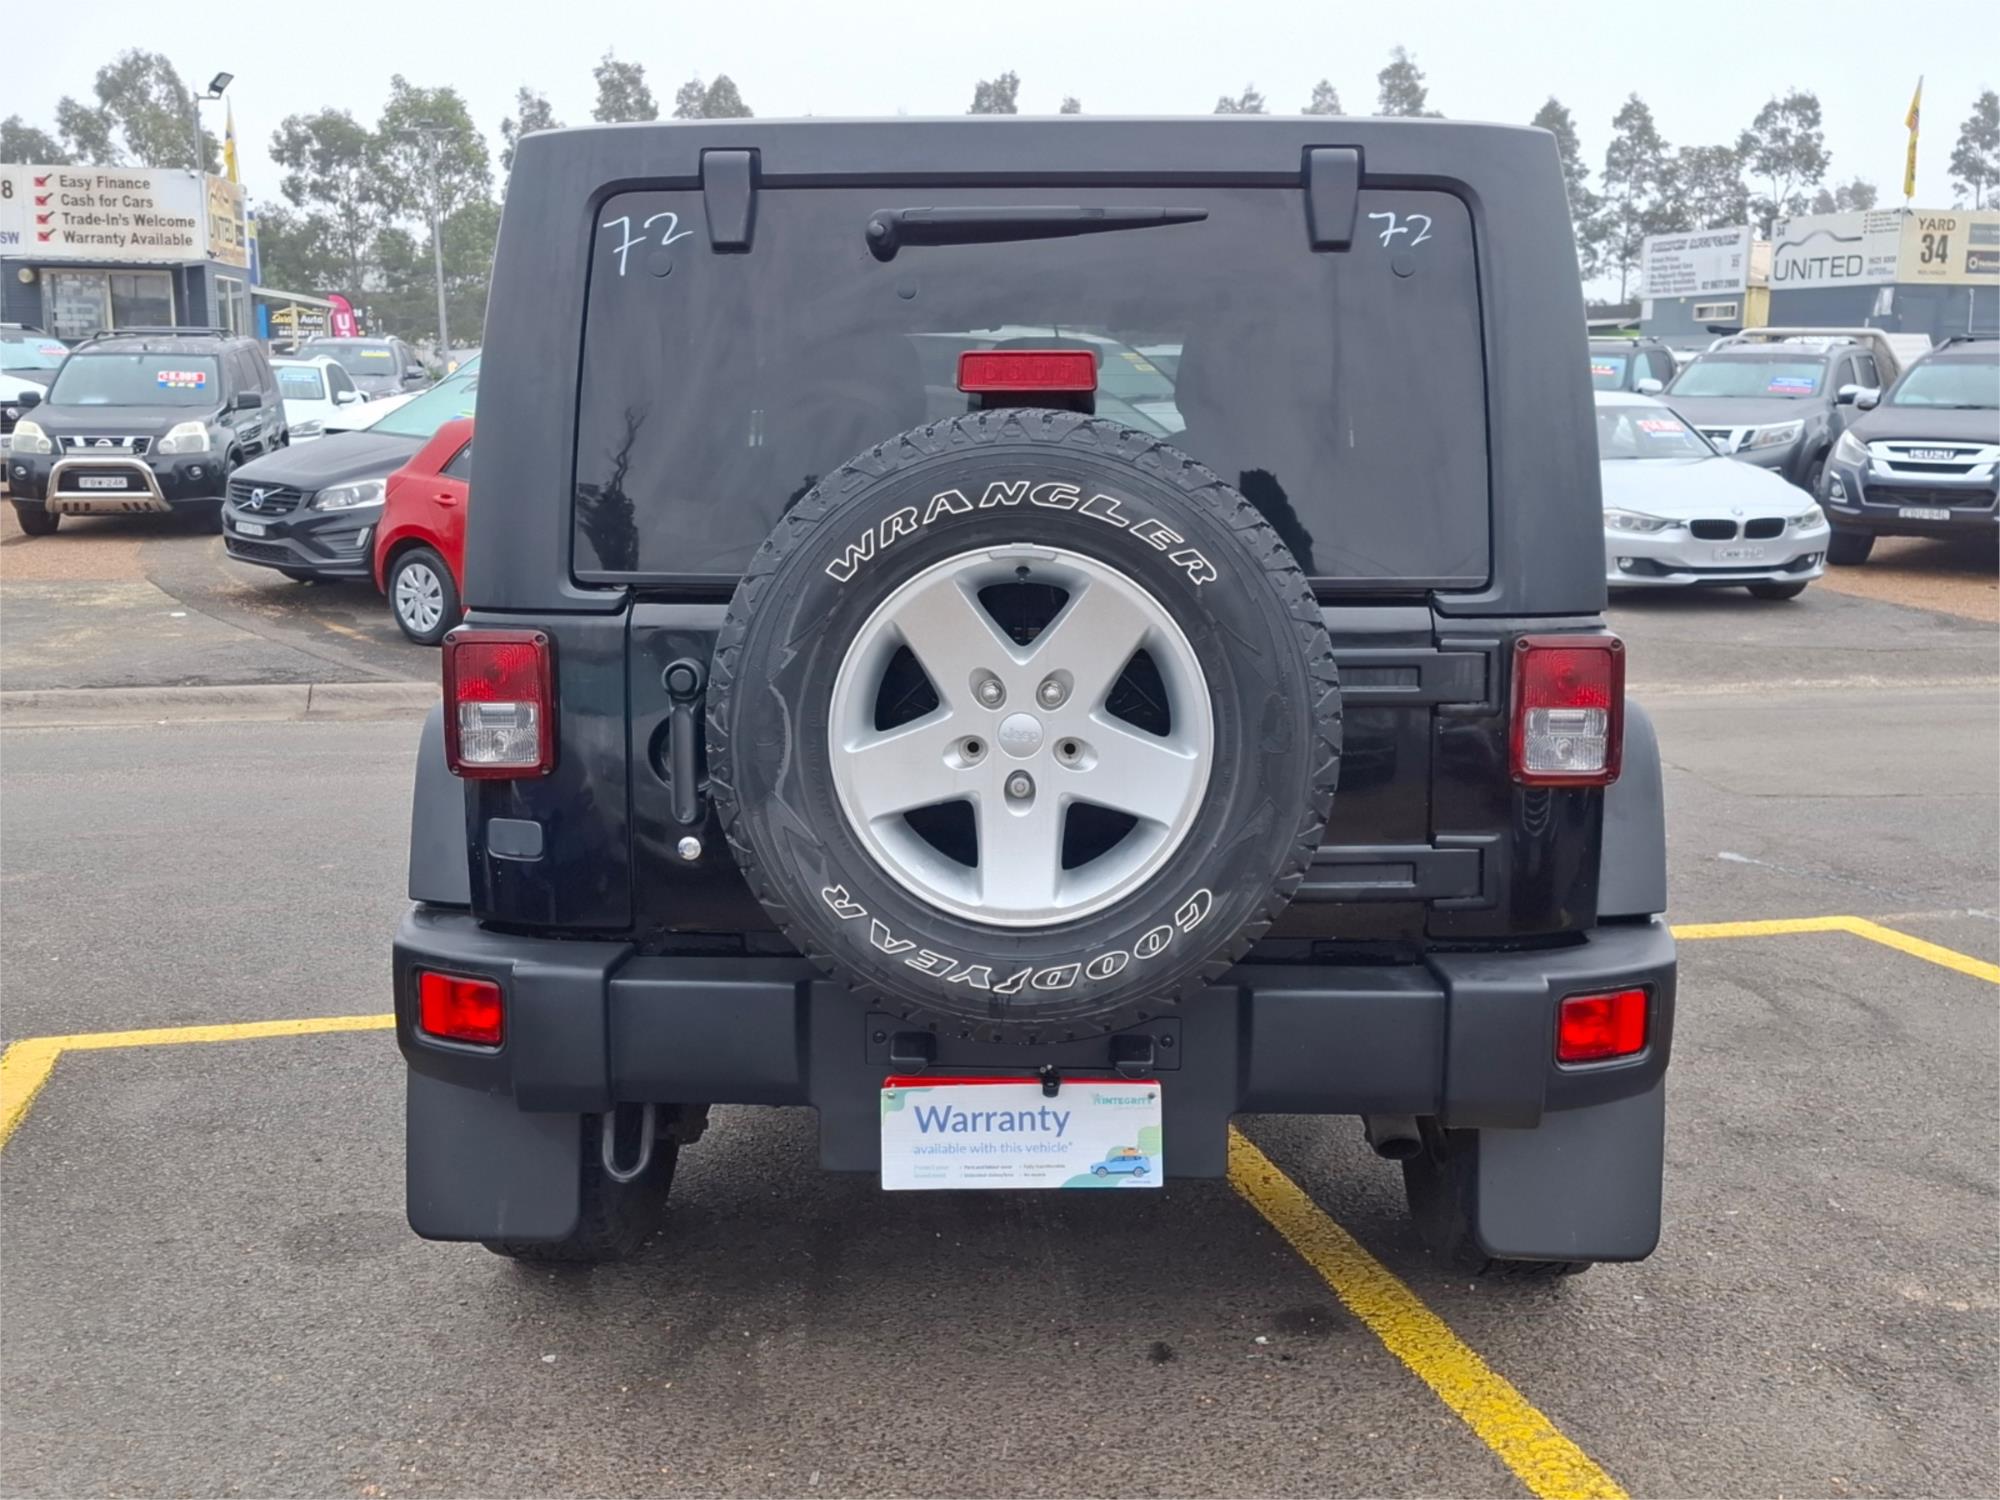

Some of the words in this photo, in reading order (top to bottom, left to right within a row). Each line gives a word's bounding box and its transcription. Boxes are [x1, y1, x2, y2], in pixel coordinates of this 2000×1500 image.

[60, 175, 92, 190] Easy
[97, 176, 150, 190] Finance
[61, 194, 95, 207] Cash
[100, 195, 117, 207] for
[123, 196, 153, 208] Cars
[62, 212, 130, 226] Trade-In's
[134, 214, 196, 228] Welcome
[1918, 217, 1957, 232] YARD
[1368, 211, 1432, 247] 72
[63, 231, 126, 247] Warranty
[131, 232, 193, 246] Available
[603, 212, 694, 276] 72
[1920, 233, 1949, 264] 34
[300, 315, 323, 324] Auto
[1909, 449, 1955, 460] ISUZU
[825, 481, 1217, 585] WRANGLER
[822, 885, 1212, 994] GOODYEAR
[914, 1104, 1071, 1138] Warranty
[913, 1143, 967, 1155] available
[970, 1143, 997, 1154] with
[1000, 1142, 1023, 1153] this
